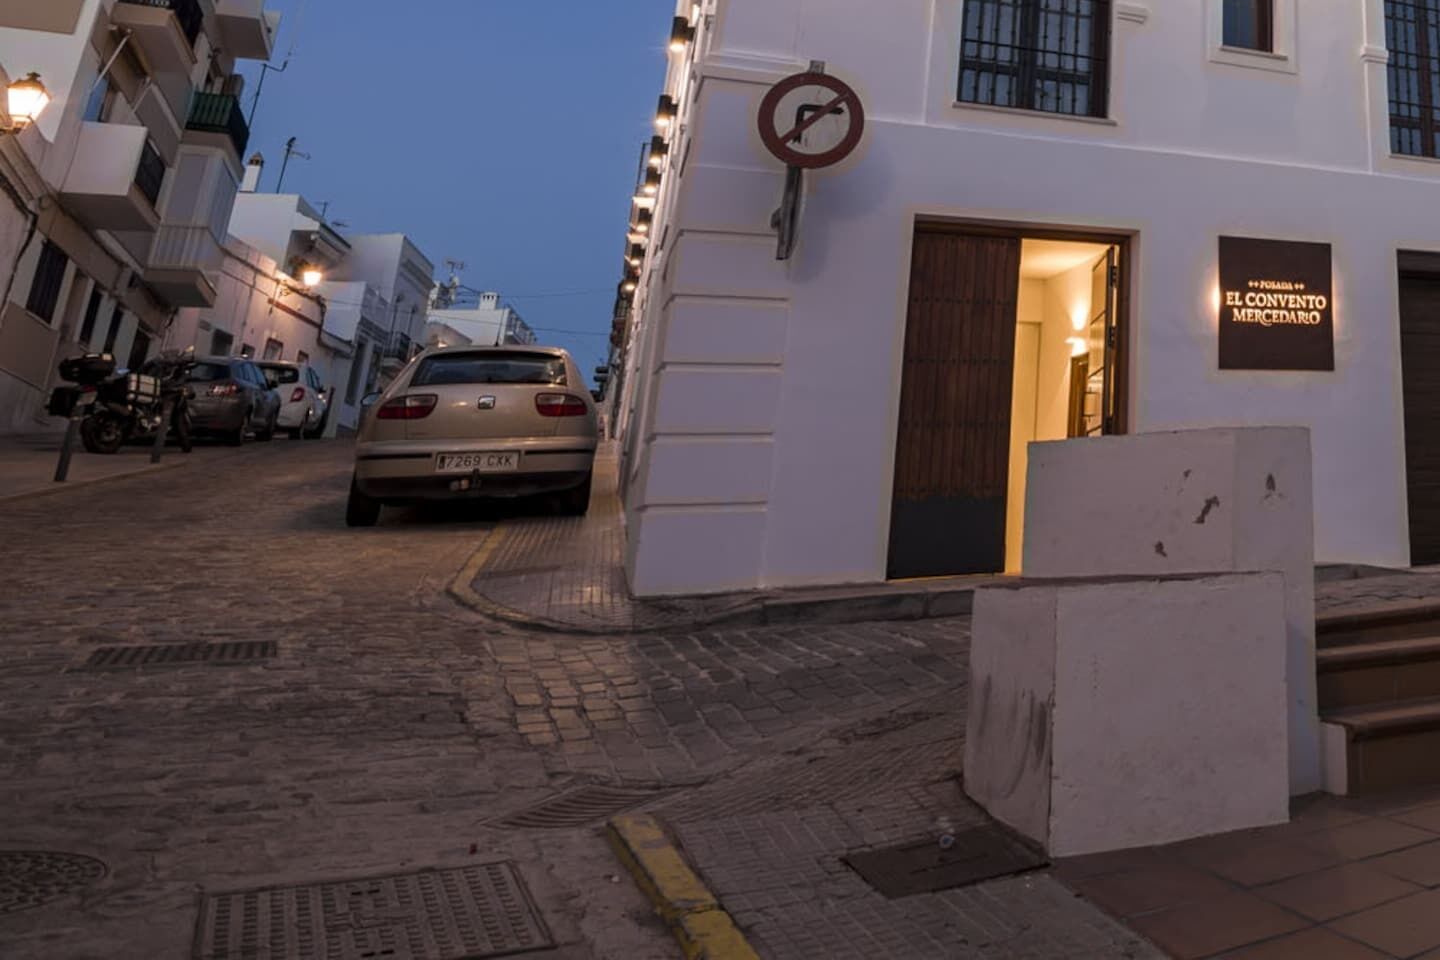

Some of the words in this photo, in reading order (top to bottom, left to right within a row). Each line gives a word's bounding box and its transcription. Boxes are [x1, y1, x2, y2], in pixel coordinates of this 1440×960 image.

[1260, 280, 1293, 290] POSADA
[1226, 291, 1242, 306] EL
[1245, 292, 1327, 310] CONVENTO
[1232, 308, 1320, 326] MERCEDARIO
[447, 455, 480, 468] 7269
[487, 455, 512, 466] CXK
